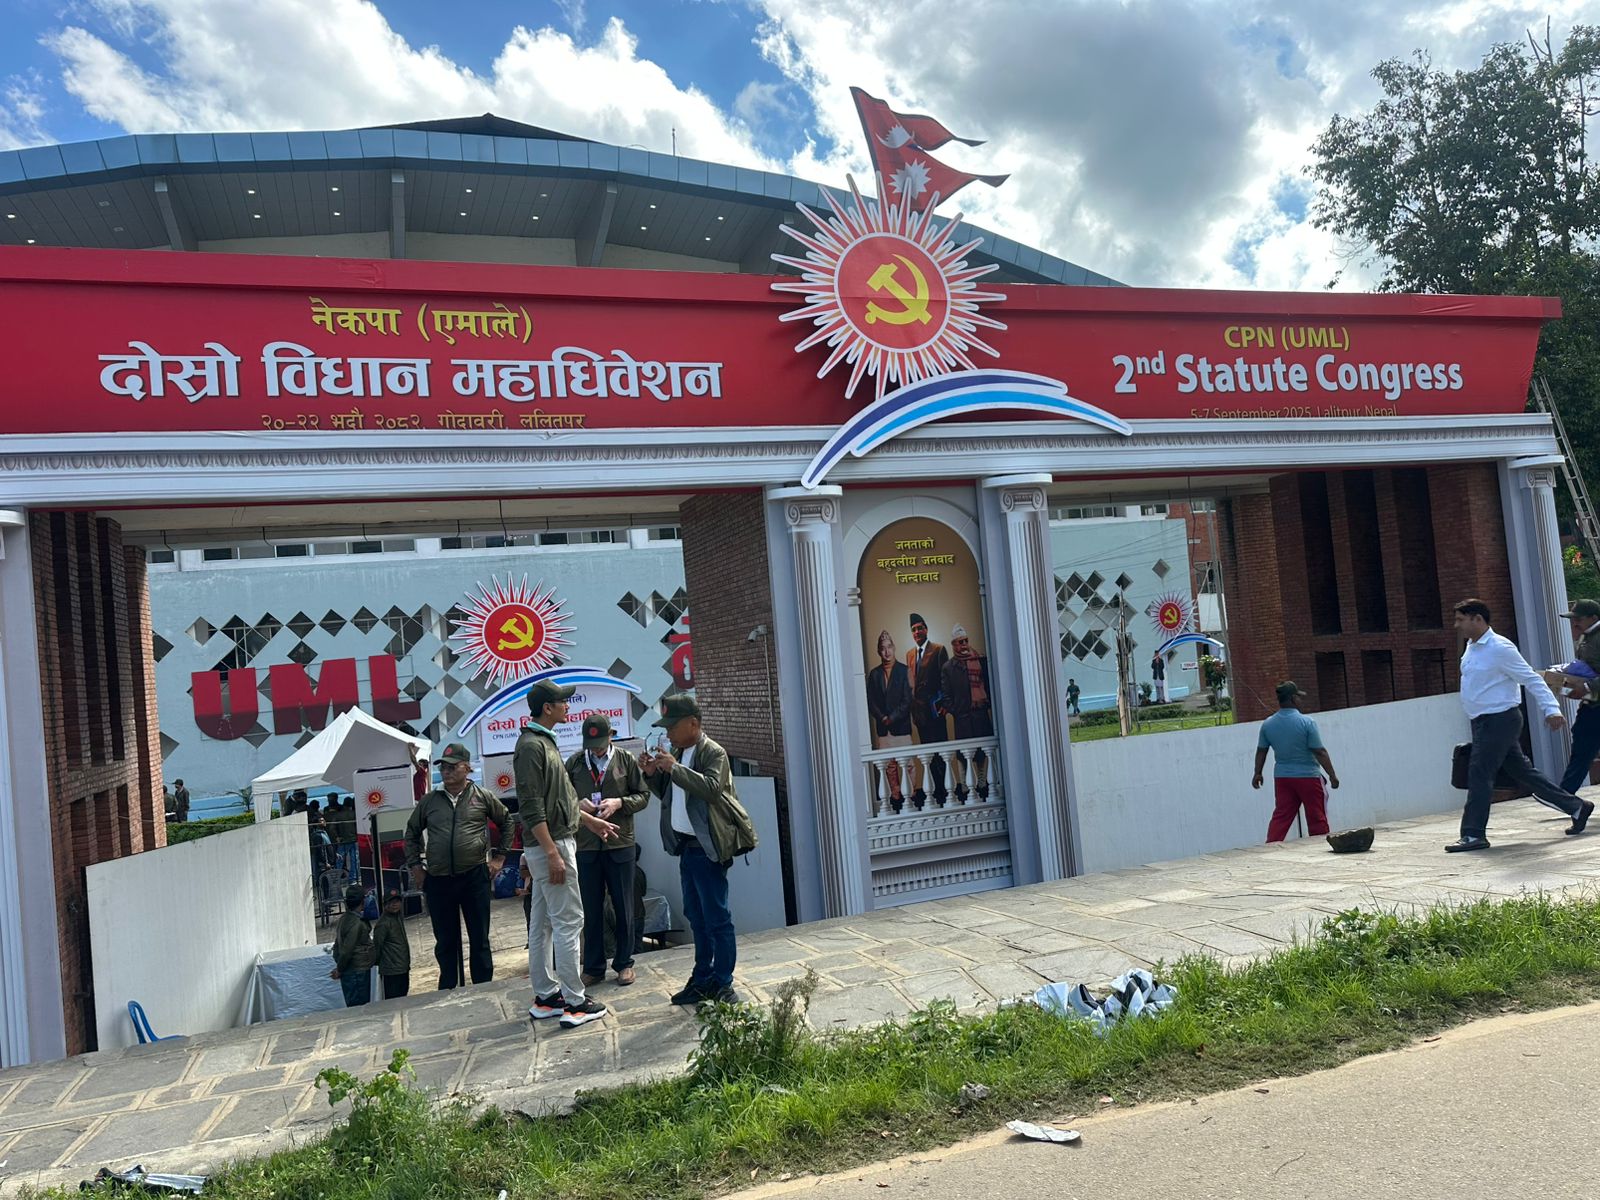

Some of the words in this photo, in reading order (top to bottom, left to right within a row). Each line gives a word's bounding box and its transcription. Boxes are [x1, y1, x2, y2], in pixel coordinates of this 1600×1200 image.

[309, 296, 402, 336] नेकपा
[417, 302, 532, 345] (एमाले)
[1224, 326, 1275, 349] CPN
[1281, 326, 1350, 351] (UML)
[98, 341, 241, 403] दोस्रो
[261, 341, 431, 398] विधान
[451, 346, 723, 402] महाधिवेशन
[1112, 351, 1166, 394] 2nd
[1175, 353, 1308, 393] Statute
[1315, 354, 1465, 400] Congress
[330, 407, 364, 430] भदौ
[895, 537, 935, 551] जनताको
[921, 554, 955, 566] जनवाद
[191, 654, 422, 741] UML
